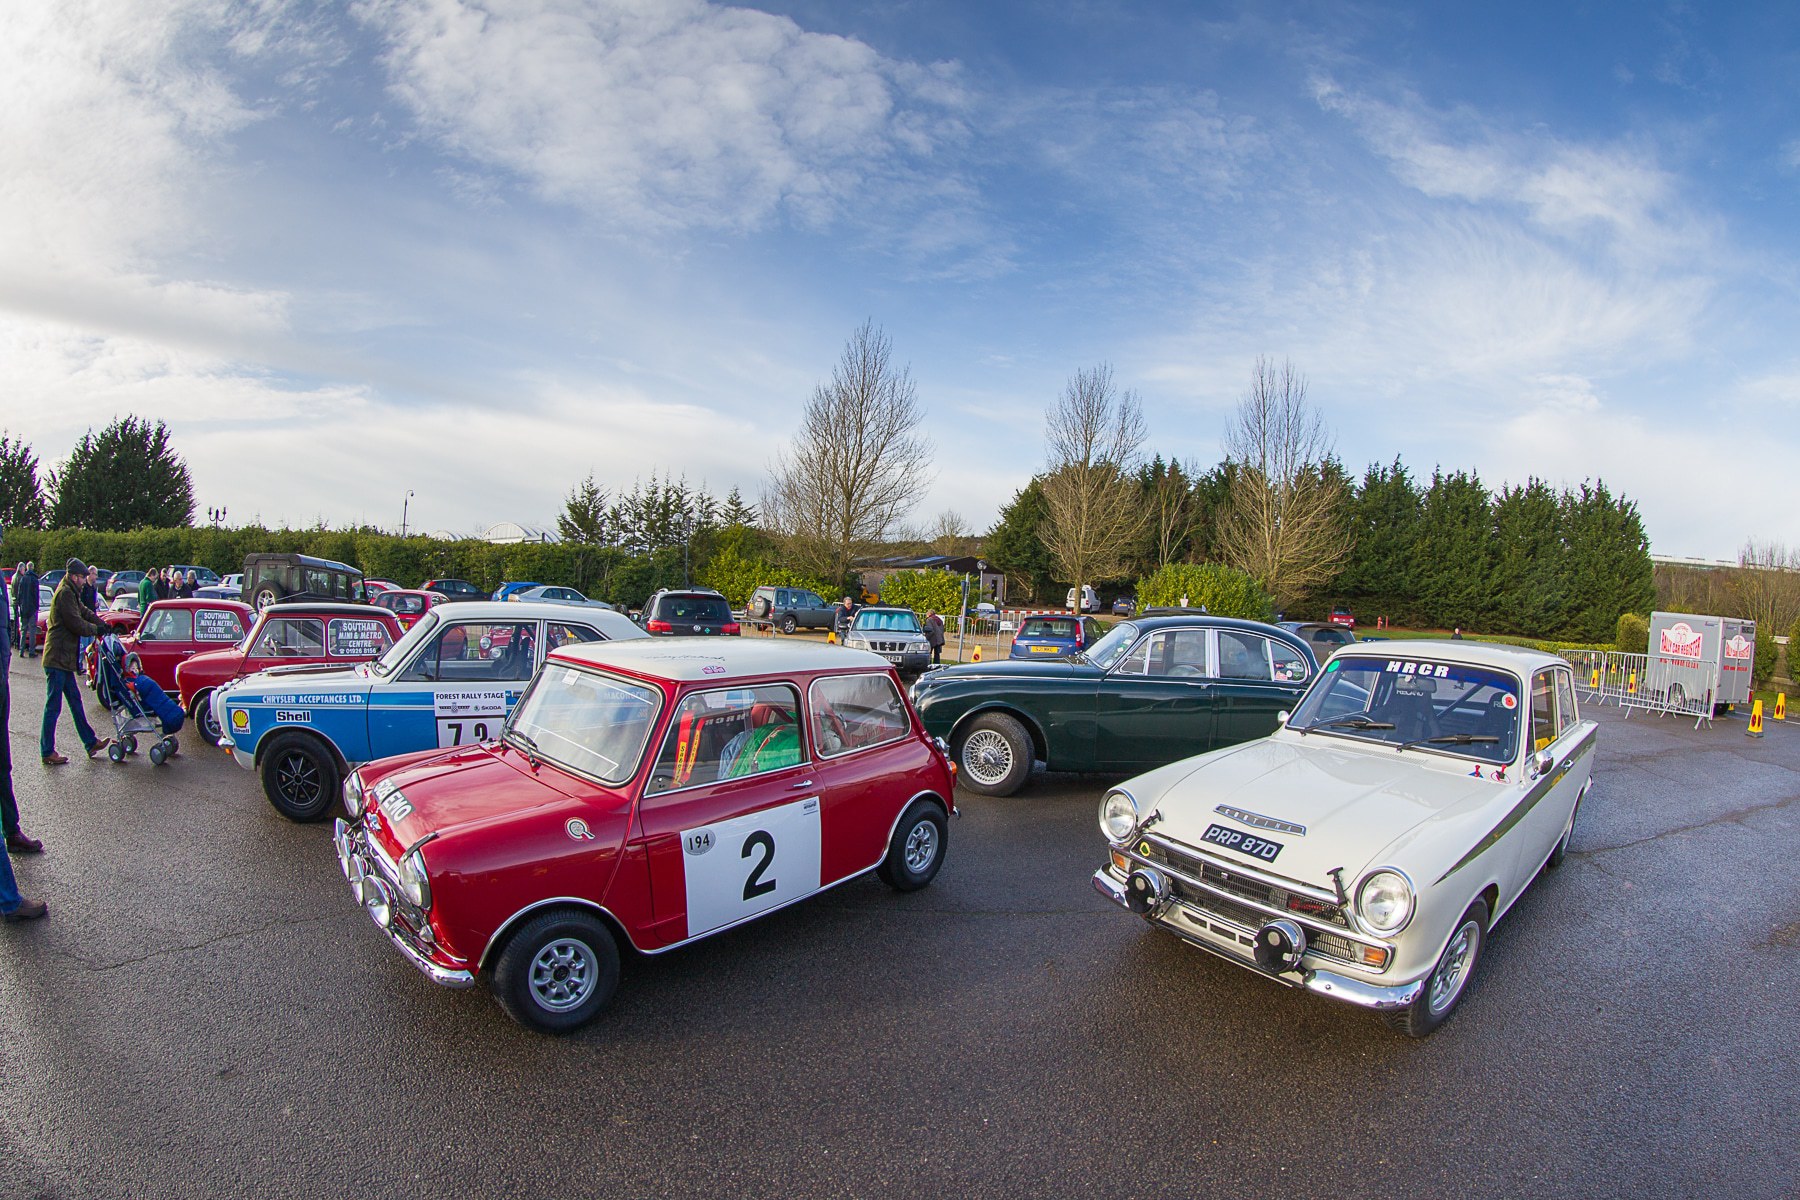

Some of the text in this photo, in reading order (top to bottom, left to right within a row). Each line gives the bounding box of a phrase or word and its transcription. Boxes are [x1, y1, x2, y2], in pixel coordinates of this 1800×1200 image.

[204, 612, 230, 620] SOUTHAM
[343, 622, 377, 631] SOUTHAM
[348, 640, 372, 648] CENTRE
[1386, 660, 1450, 678] HRCR
[262, 694, 364, 704] CHRYSLER ACCEPTANCES LTD.
[277, 711, 310, 722] Shell
[382, 790, 412, 822] EMO
[1224, 808, 1293, 831] CORTINA
[688, 833, 710, 850] 194
[1206, 827, 1278, 858] PRP 87D
[741, 830, 776, 902] 2
